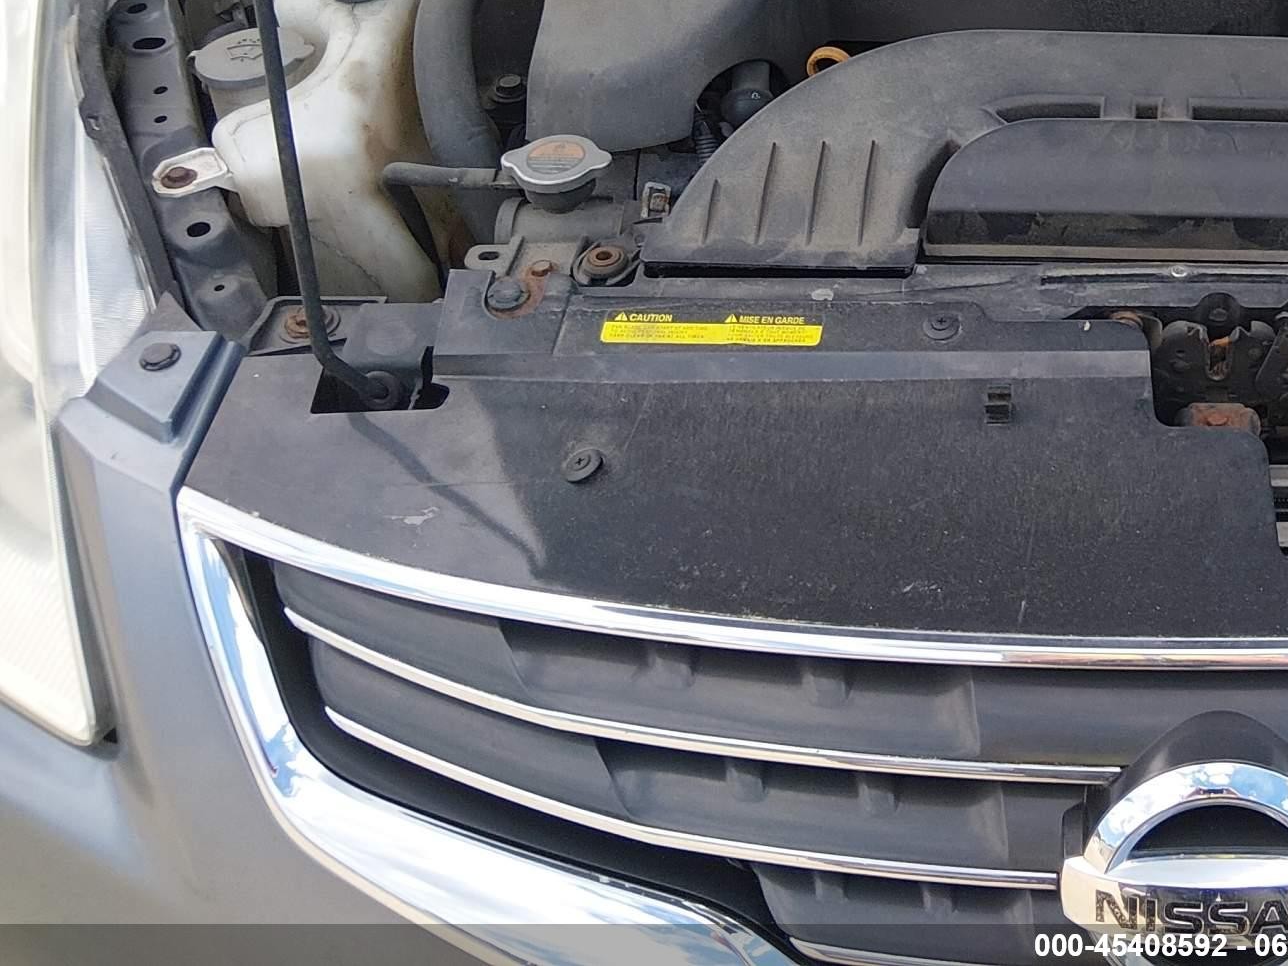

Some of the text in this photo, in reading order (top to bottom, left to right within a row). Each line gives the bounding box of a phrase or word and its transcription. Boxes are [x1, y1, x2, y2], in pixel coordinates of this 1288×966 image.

[629, 313, 673, 323] CAUTION
[738, 315, 805, 325] MISE EN GARDE
